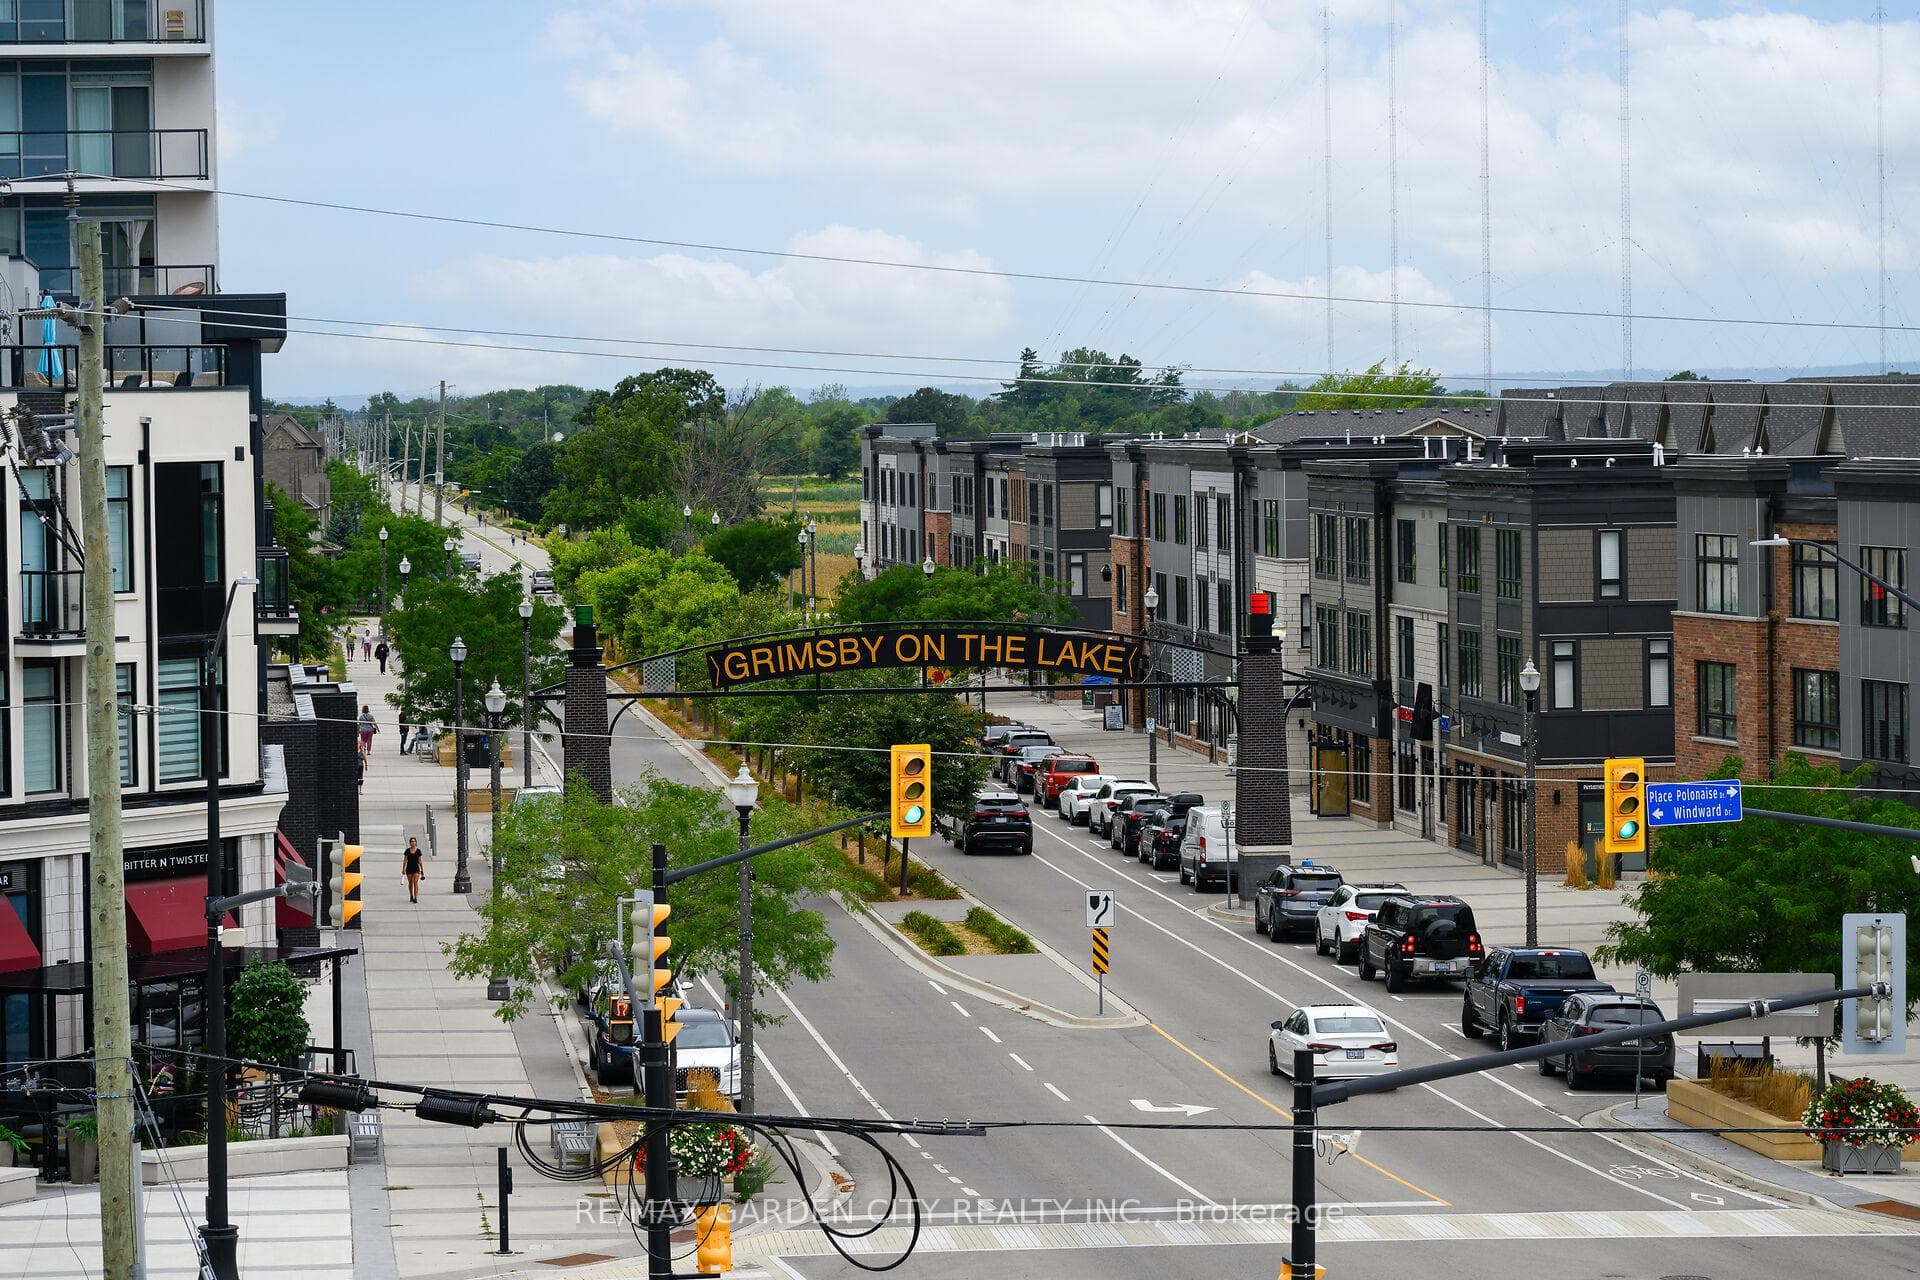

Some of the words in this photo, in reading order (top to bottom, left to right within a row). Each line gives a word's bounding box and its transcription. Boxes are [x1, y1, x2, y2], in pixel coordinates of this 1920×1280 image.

[724, 634, 884, 680] GRIMSBY
[895, 634, 945, 662] ON
[958, 634, 1026, 663] THE
[1038, 638, 1125, 673] LAKE
[1649, 790, 1673, 803] Place
[1676, 787, 1718, 802] Polonaise
[1673, 803, 1722, 819] Windward
[124, 859, 157, 871] BITTER
[160, 857, 168, 868] N
